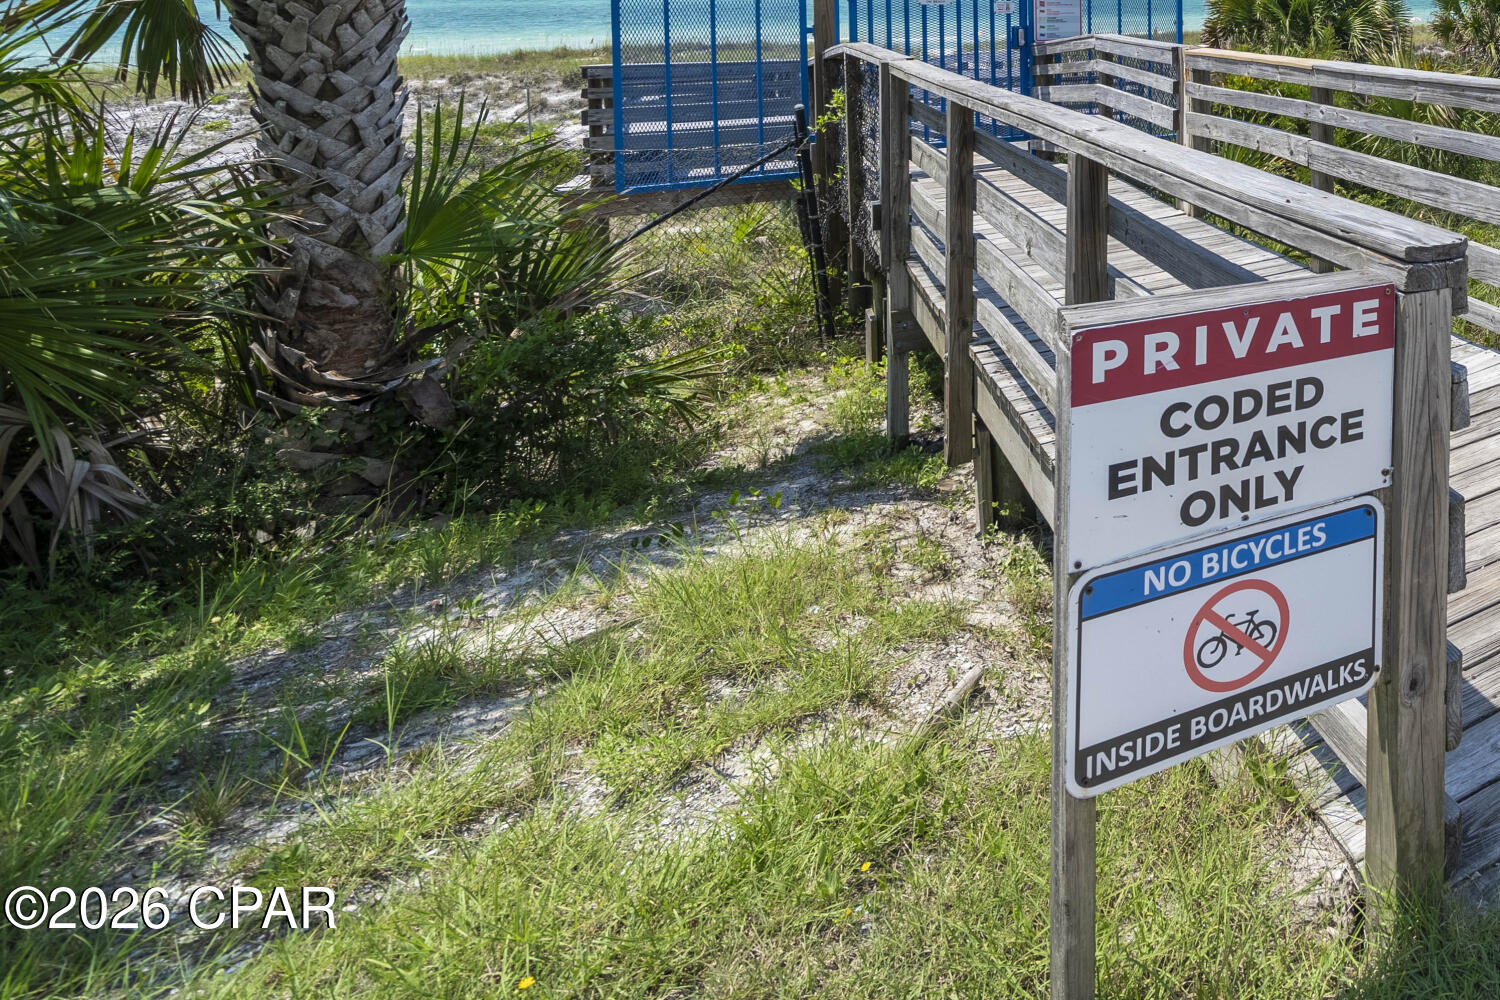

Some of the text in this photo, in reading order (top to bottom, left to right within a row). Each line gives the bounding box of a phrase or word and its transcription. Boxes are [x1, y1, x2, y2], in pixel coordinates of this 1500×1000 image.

[1092, 298, 1379, 384] PRIVATE
[1160, 376, 1324, 438] CODED
[1108, 409, 1364, 500] ENTRANCE
[1180, 465, 1304, 527] ONLY
[1143, 522, 1327, 596] NO BICYCLES
[1086, 658, 1366, 779] INSIDE BOARDWALKS
